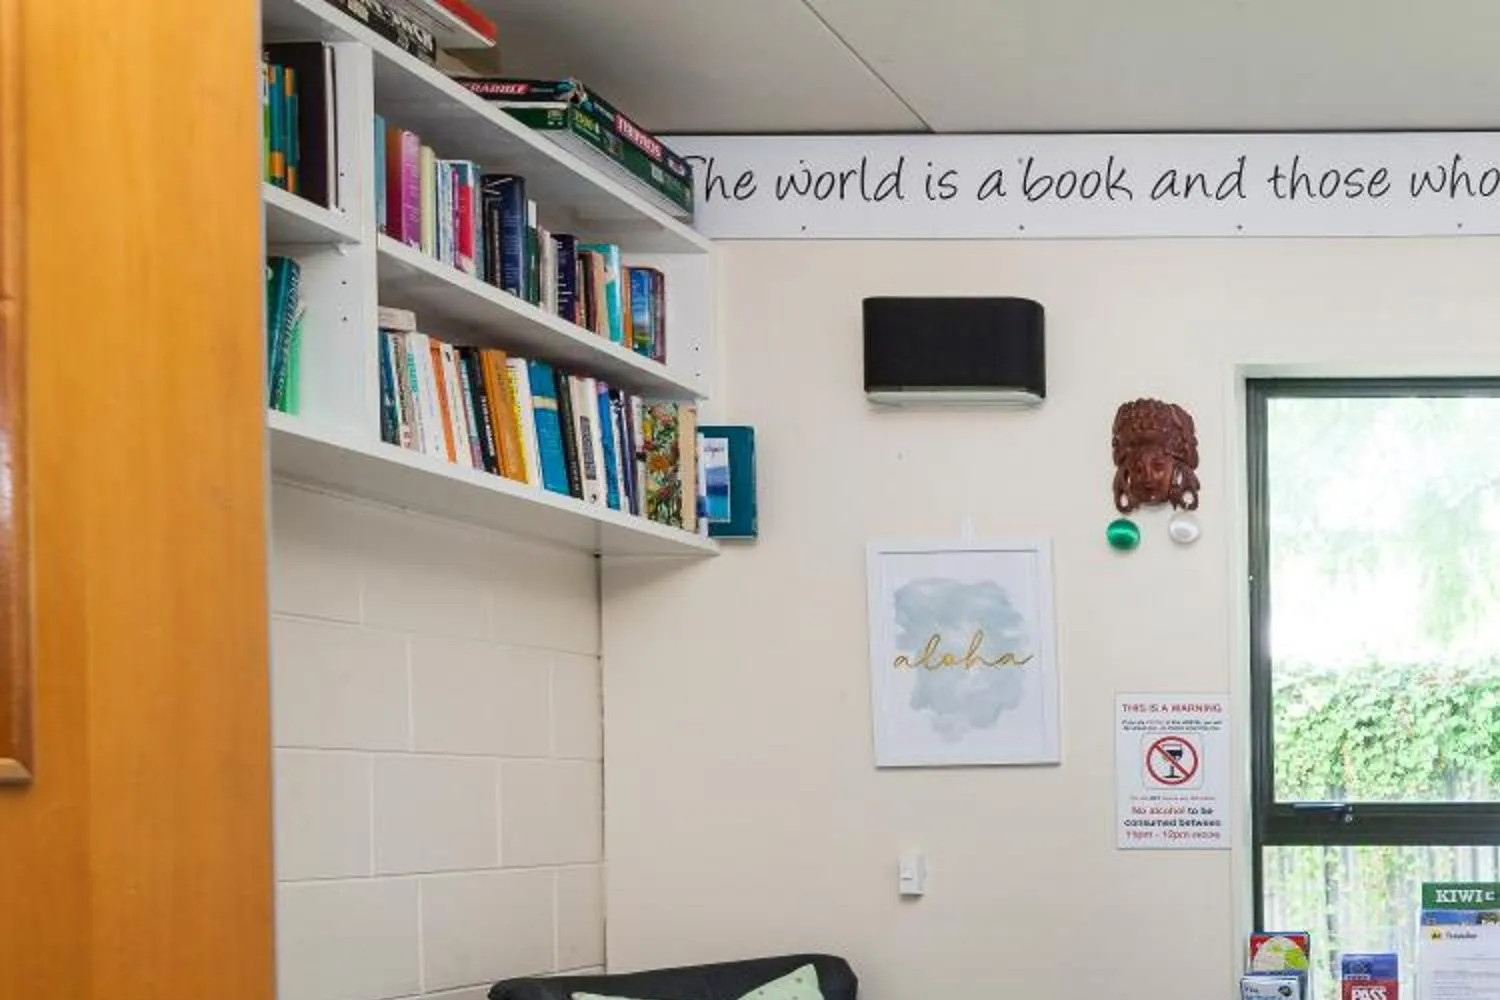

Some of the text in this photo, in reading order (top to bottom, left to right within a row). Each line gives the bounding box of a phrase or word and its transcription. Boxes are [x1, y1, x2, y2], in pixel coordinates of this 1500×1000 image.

[776, 156, 905, 203] world
[925, 161, 959, 202] is
[976, 168, 1007, 202] a
[1022, 155, 1134, 203] book
[1150, 154, 1247, 201] and
[1266, 154, 1391, 201] those
[893, 629, 1035, 671] aloha
[1121, 703, 1146, 713] THIS
[1170, 703, 1223, 713] WARNING
[1435, 888, 1483, 903] KIWI
